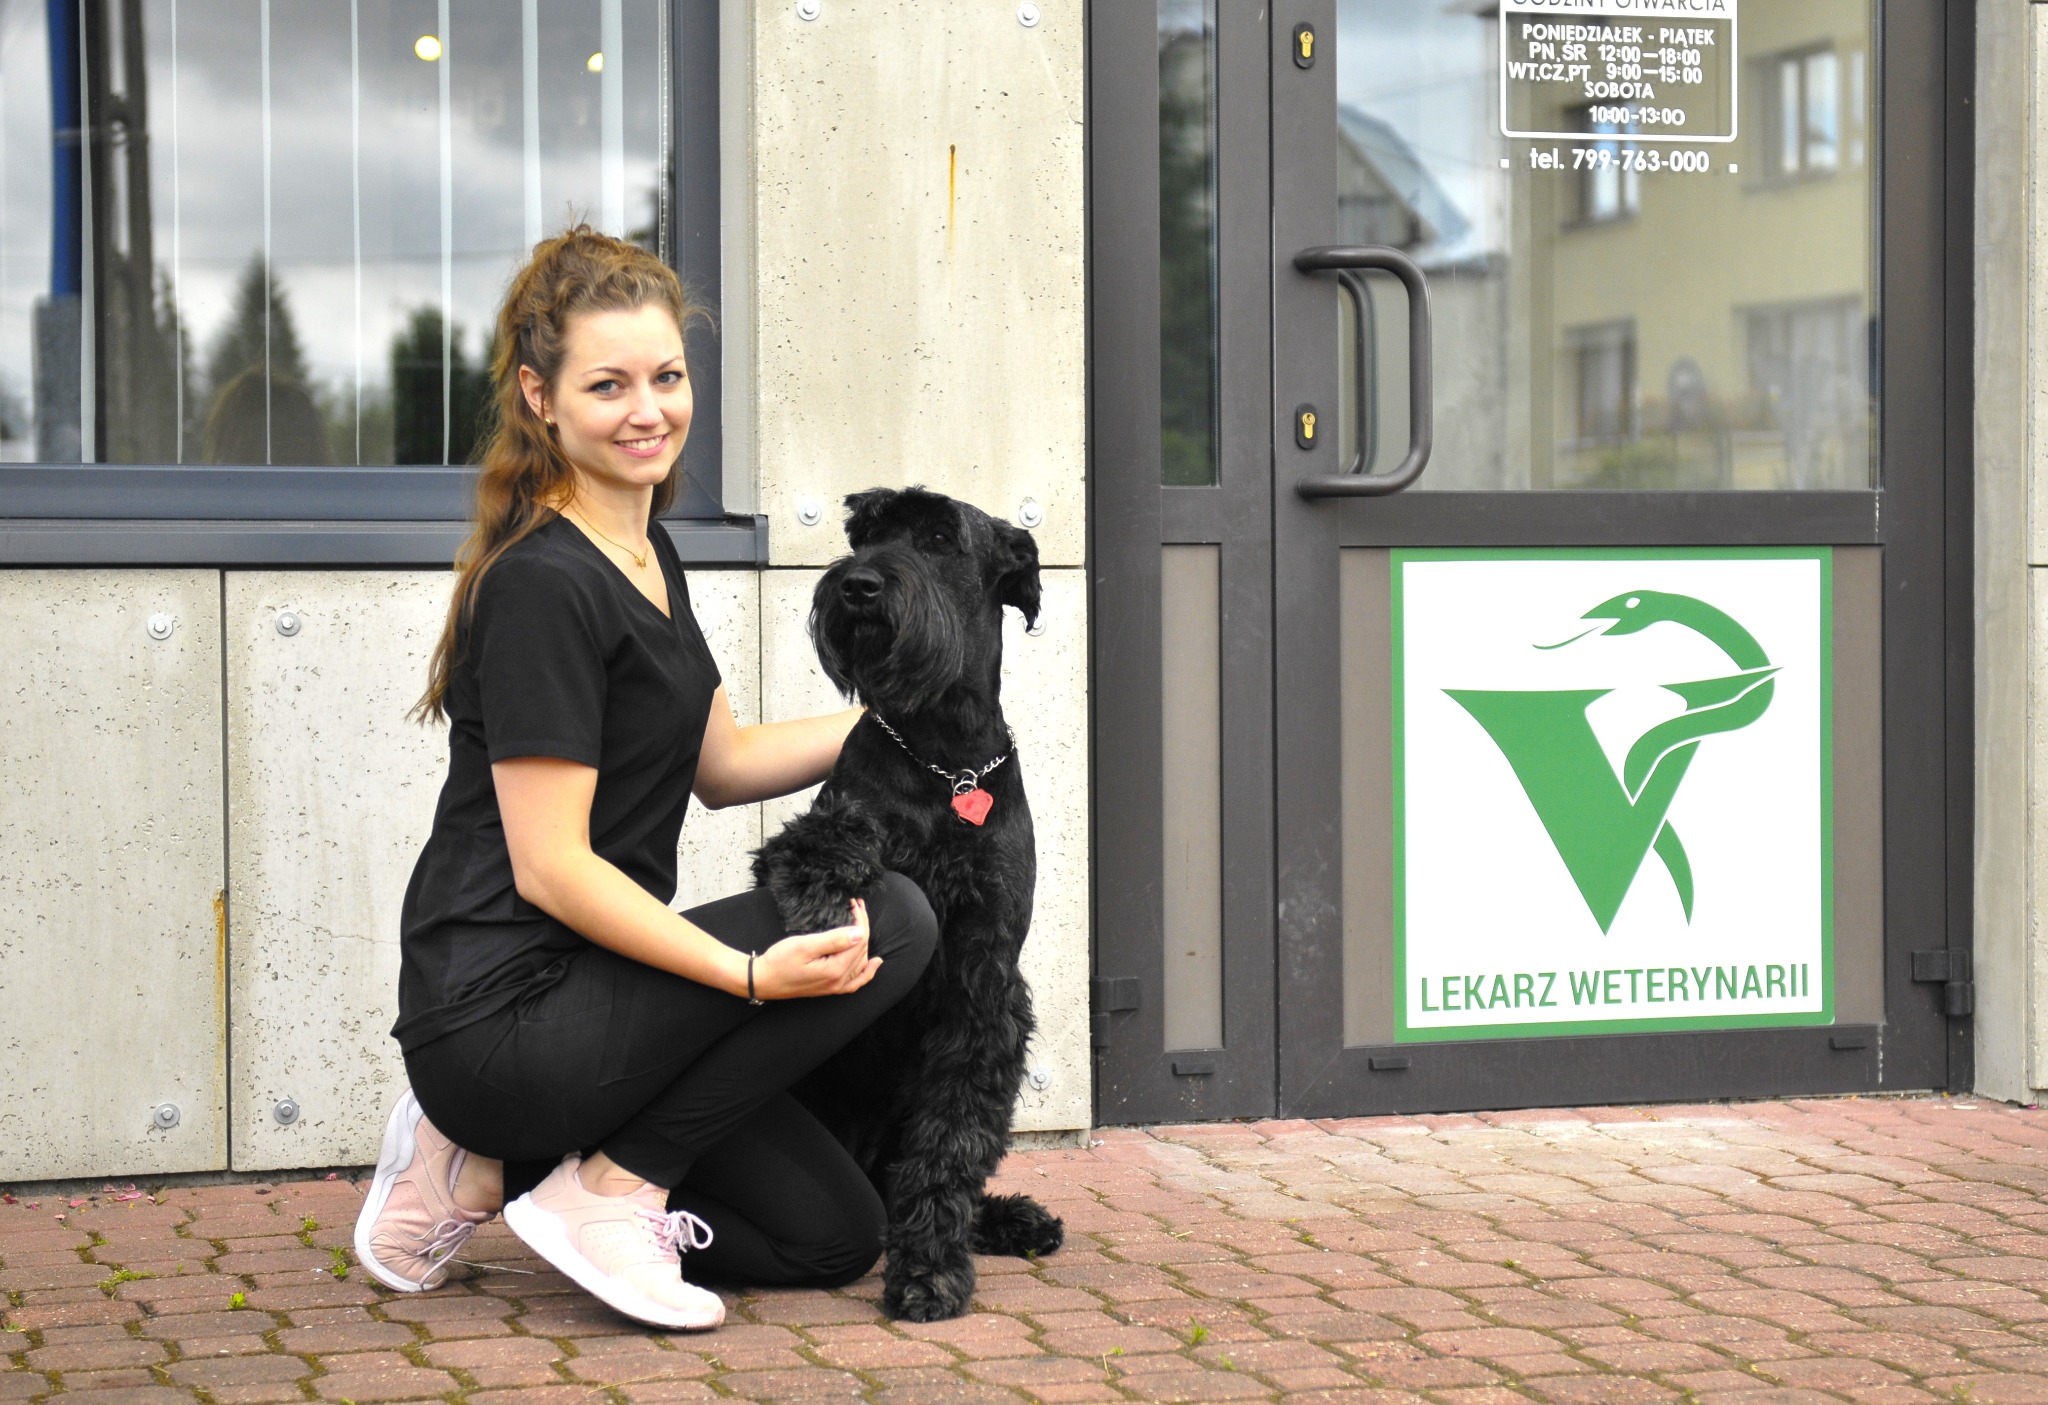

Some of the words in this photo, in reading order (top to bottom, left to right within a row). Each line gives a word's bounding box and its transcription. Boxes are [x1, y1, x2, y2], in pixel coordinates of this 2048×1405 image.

[1522, 24, 1643, 43] PONIEDZIAŁEK
[1659, 28, 1715, 47] PIĄTEK
[1584, 81, 1655, 99] SOBOTA
[1530, 148, 1565, 170] tel.
[1572, 149, 1710, 173] 799-763-000
[1421, 972, 1557, 1012] LEKARZ
[1569, 963, 1809, 1006] WETERYNARII
